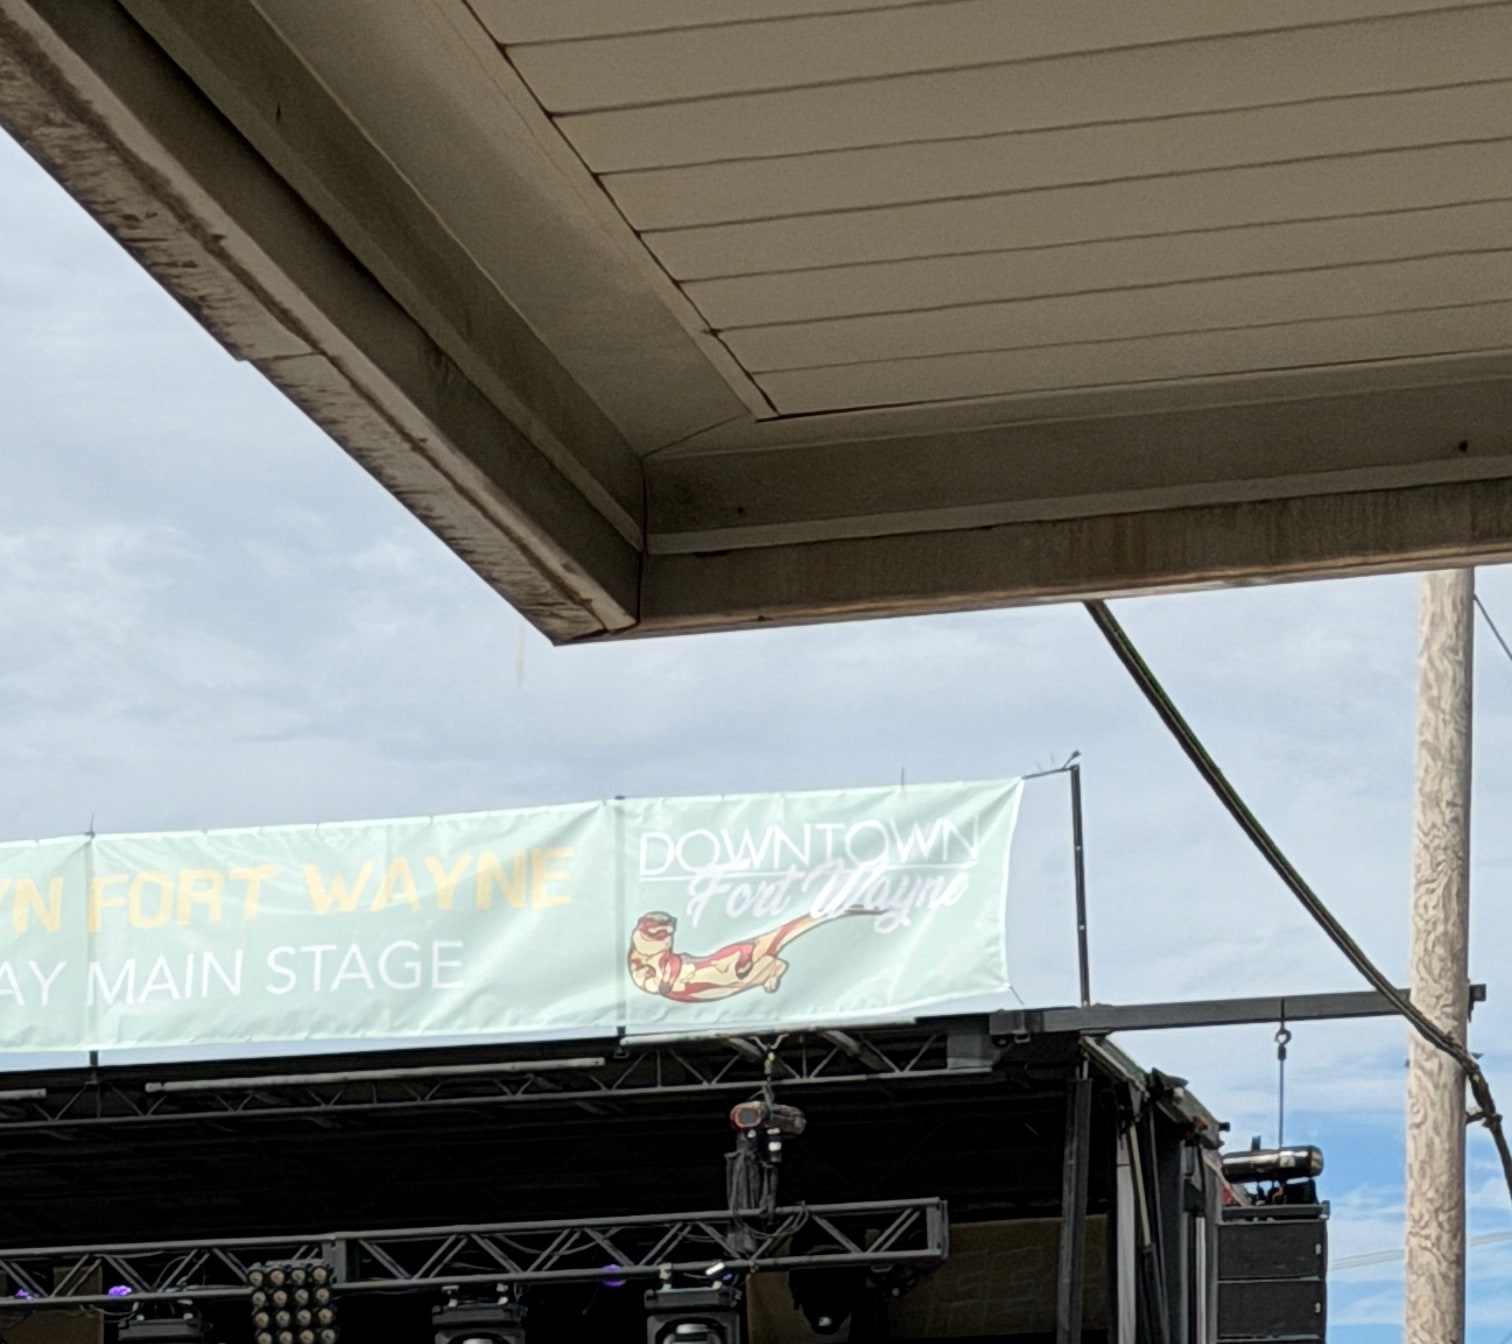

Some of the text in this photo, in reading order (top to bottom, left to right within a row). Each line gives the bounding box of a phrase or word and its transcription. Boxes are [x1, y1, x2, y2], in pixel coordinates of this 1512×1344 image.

[640, 816, 980, 876] DOWNTOWN
[87, 863, 278, 934] FORT
[301, 847, 576, 916] WAYNE
[686, 856, 970, 934] Fort Wayne
[86, 949, 244, 1007] MAIN
[265, 938, 466, 995] STAGE
